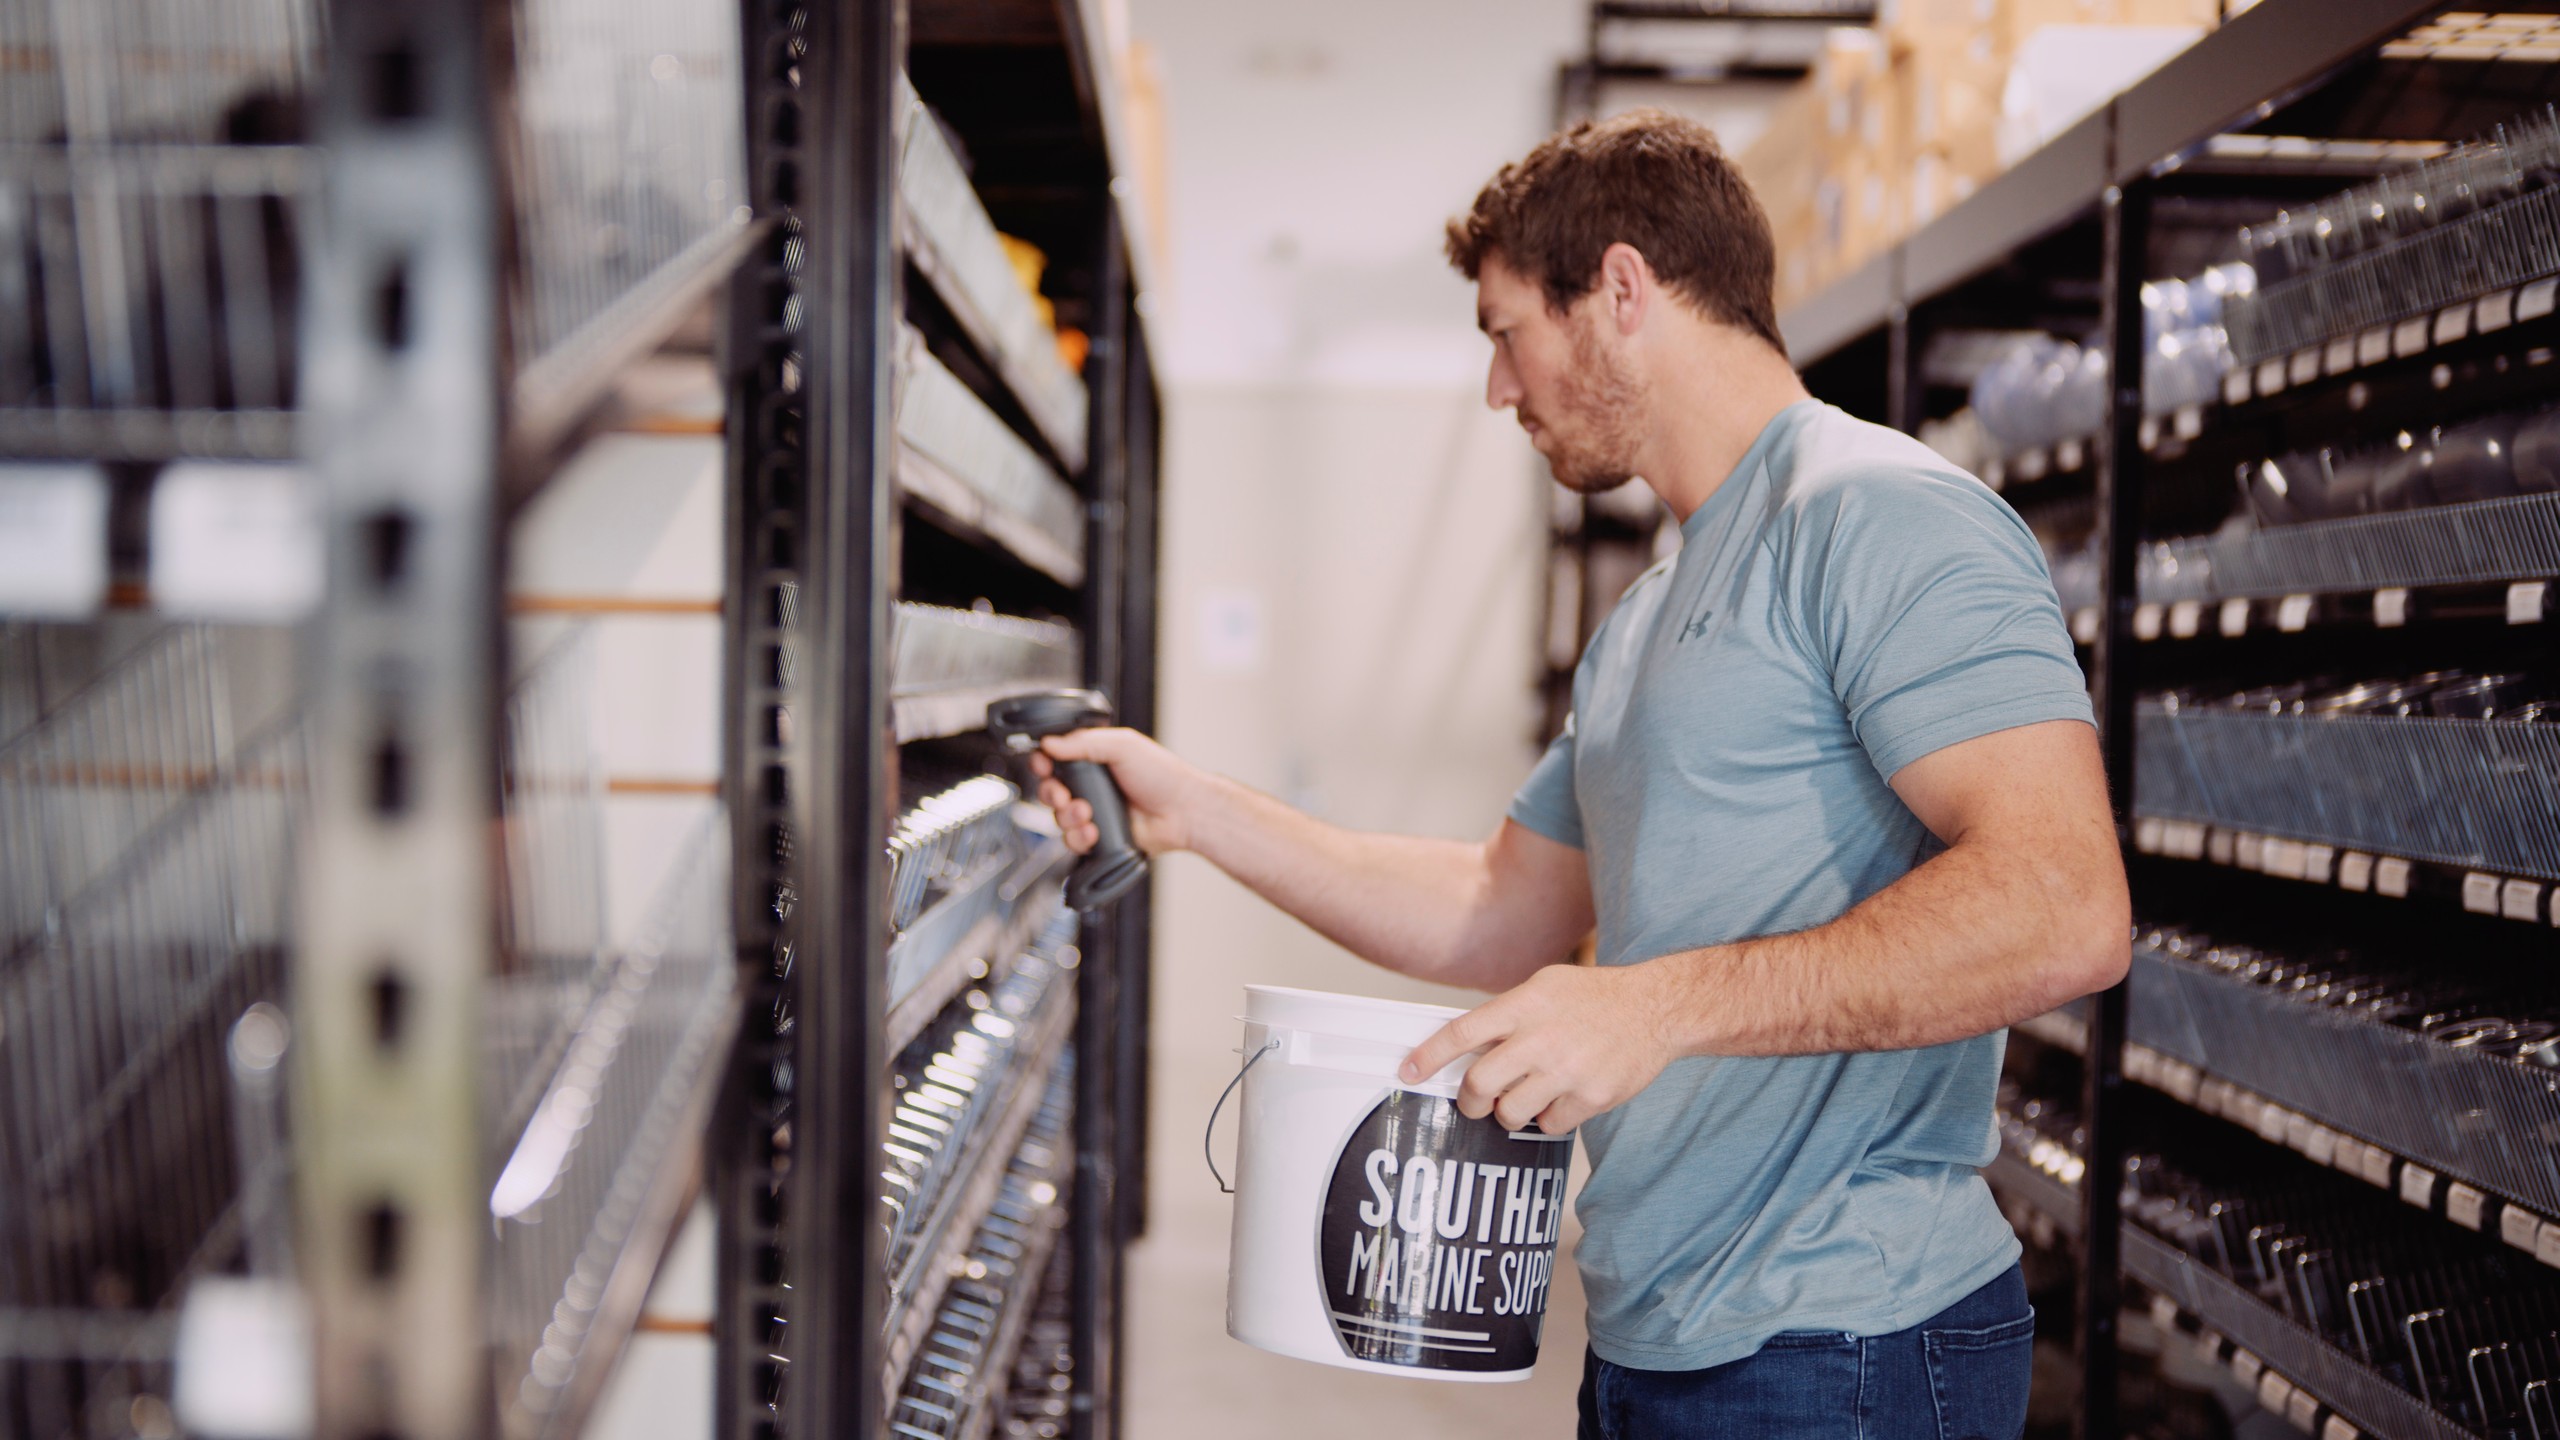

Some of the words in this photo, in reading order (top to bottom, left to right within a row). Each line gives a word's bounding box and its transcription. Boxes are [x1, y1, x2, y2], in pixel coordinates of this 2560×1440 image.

[1359, 1149, 1567, 1244] SOUTHER
[1347, 1231, 1492, 1315] MARINE
[1495, 1249, 1555, 1315] SUPP
